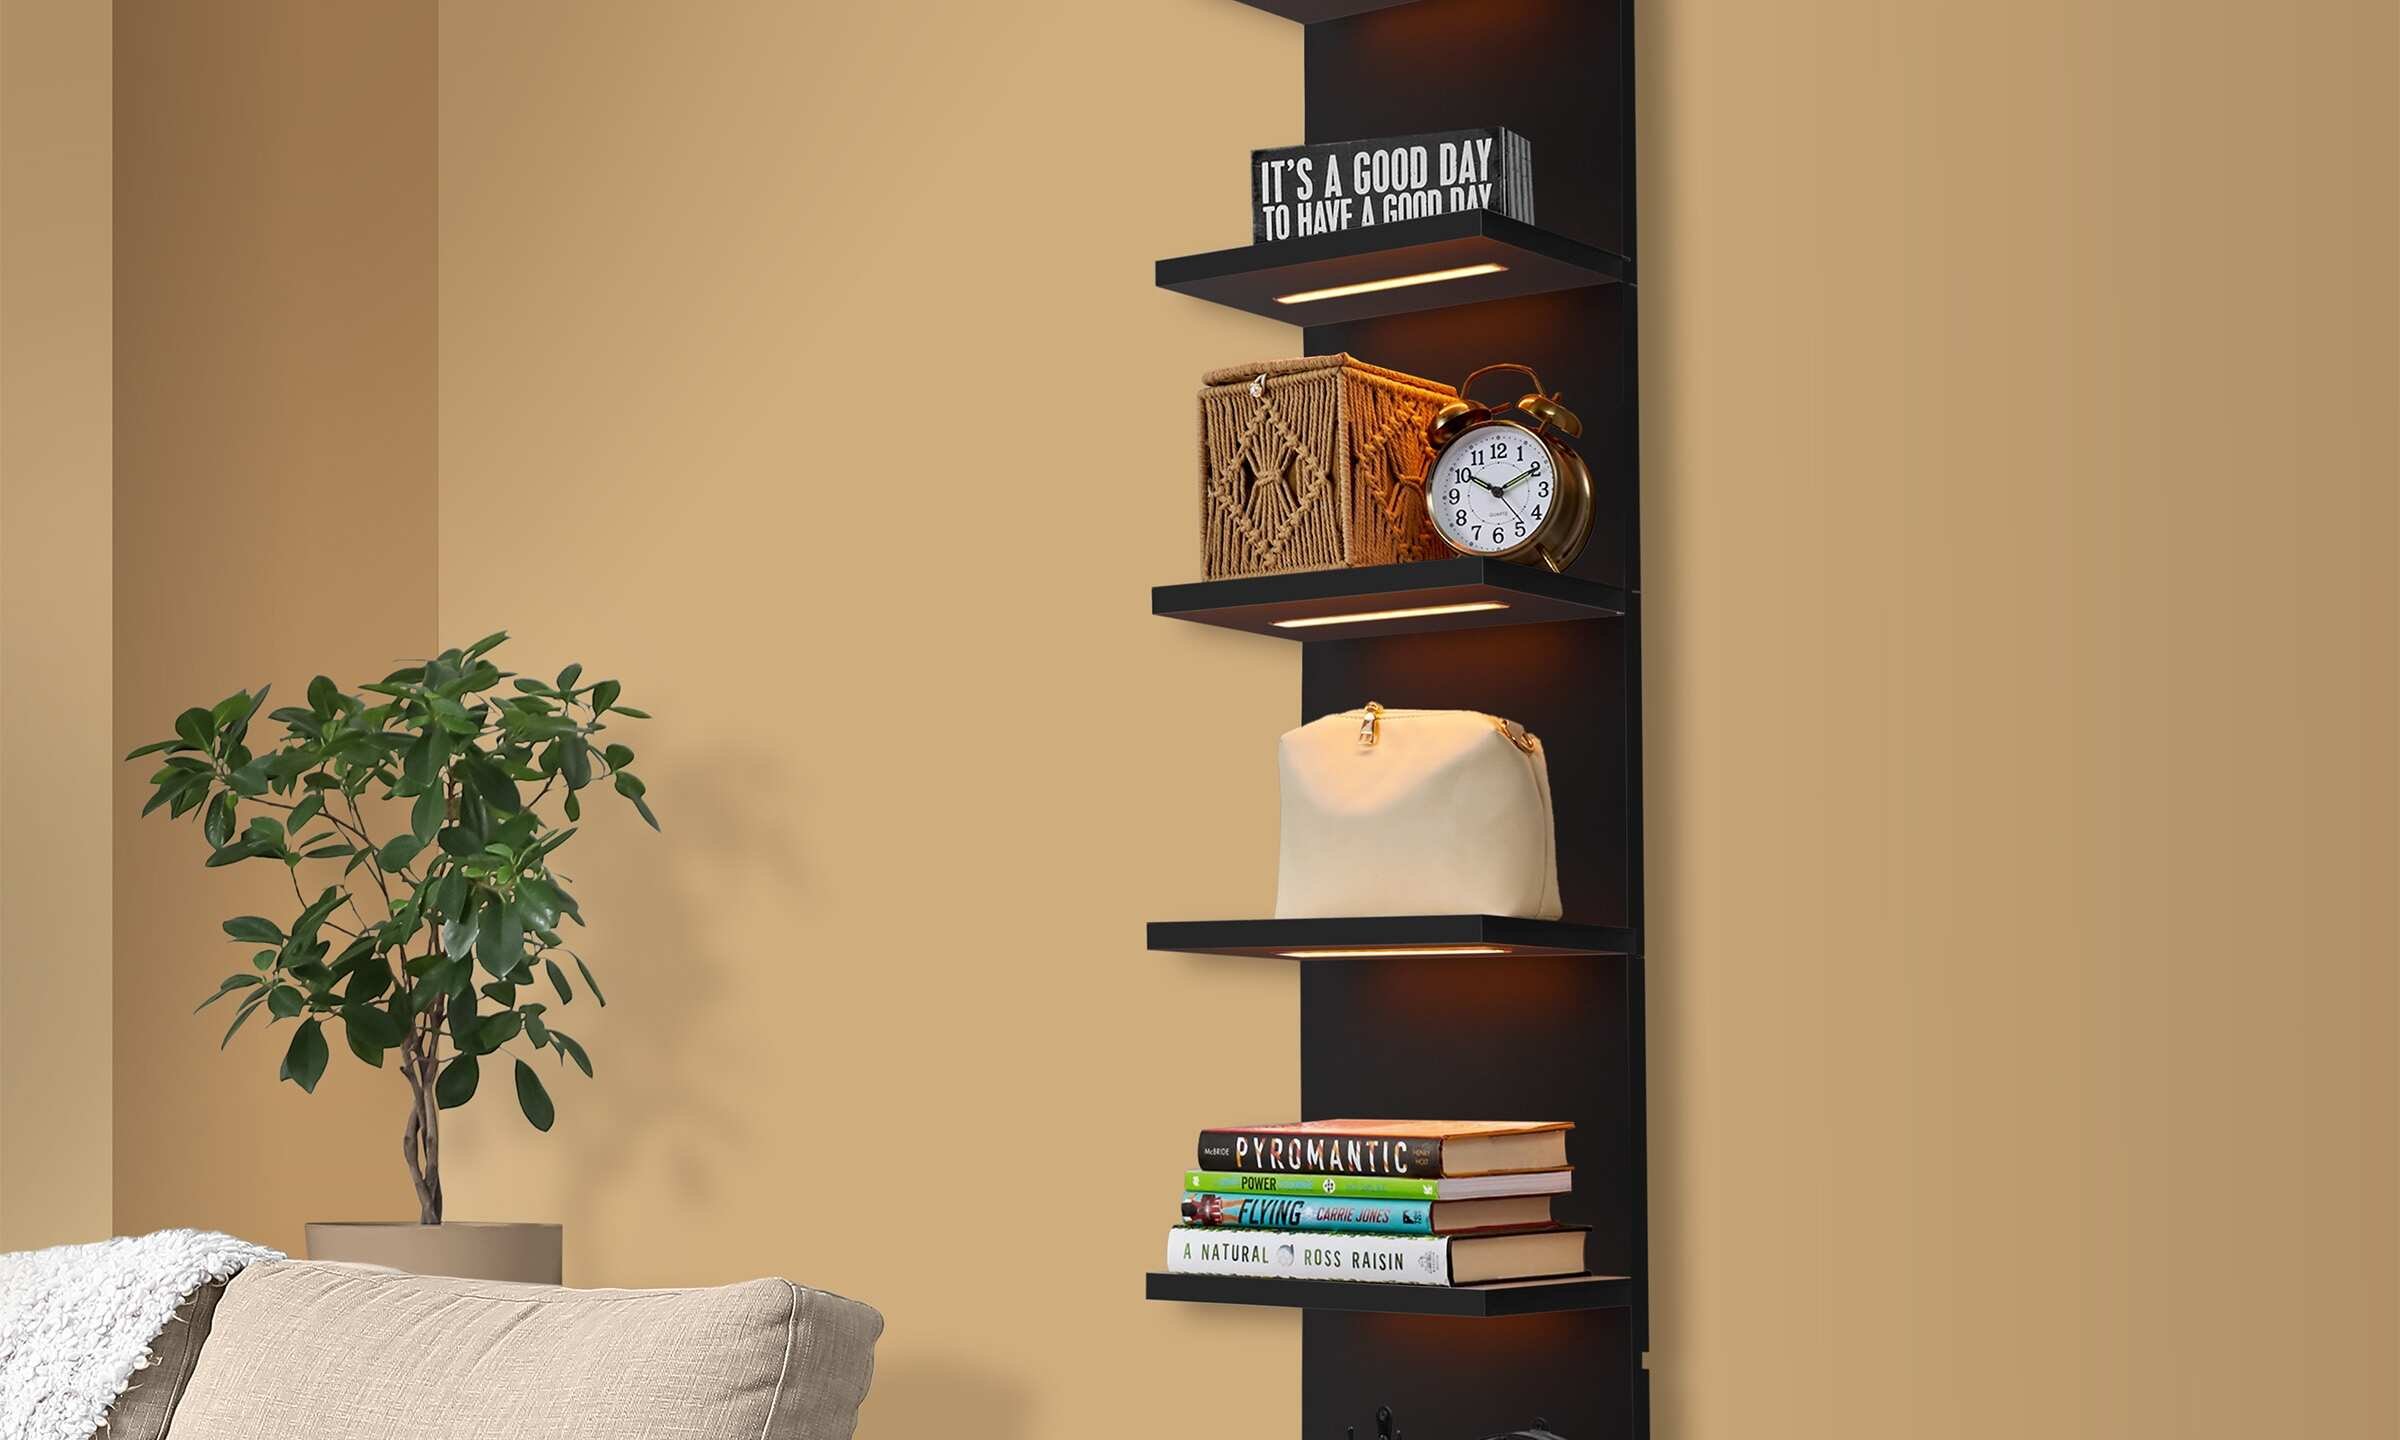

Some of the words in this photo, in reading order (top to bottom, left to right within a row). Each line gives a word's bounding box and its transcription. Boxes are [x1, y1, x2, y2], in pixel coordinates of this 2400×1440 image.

[1261, 157, 1313, 204] IT’S
[1324, 154, 1343, 198] A
[1353, 145, 1428, 195] GOOD
[1439, 138, 1493, 187] DAY
[1262, 204, 1290, 241] TO
[1297, 198, 1353, 237] HAVE
[1361, 195, 1375, 227] A
[1383, 189, 1442, 224] GOOD
[1450, 183, 1493, 213] DAY
[1471, 450, 1485, 466] 11
[1490, 443, 1508, 459] 12
[1516, 446, 1524, 461] 1
[1455, 467, 1472, 484] 10
[1530, 461, 1541, 477] 2
[1449, 488, 1460, 504] 9
[1538, 481, 1549, 497] 3
[1456, 509, 1467, 526] 8
[1531, 504, 1543, 520] 4
[1471, 525, 1482, 540] 7
[1492, 527, 1504, 543] 6
[1515, 521, 1526, 537] 5
[1236, 1137, 1407, 1174] PYROMANTIC
[1241, 1176, 1277, 1191] POWER
[1238, 1199, 1305, 1226] FLYING
[1316, 1206, 1354, 1222] CARRIE
[1356, 1207, 1391, 1224] JONES
[1183, 1243, 1191, 1260] A
[1201, 1243, 1269, 1264] NATURAL
[1304, 1249, 1341, 1268] ROSS
[1352, 1251, 1404, 1271] RAISIN
